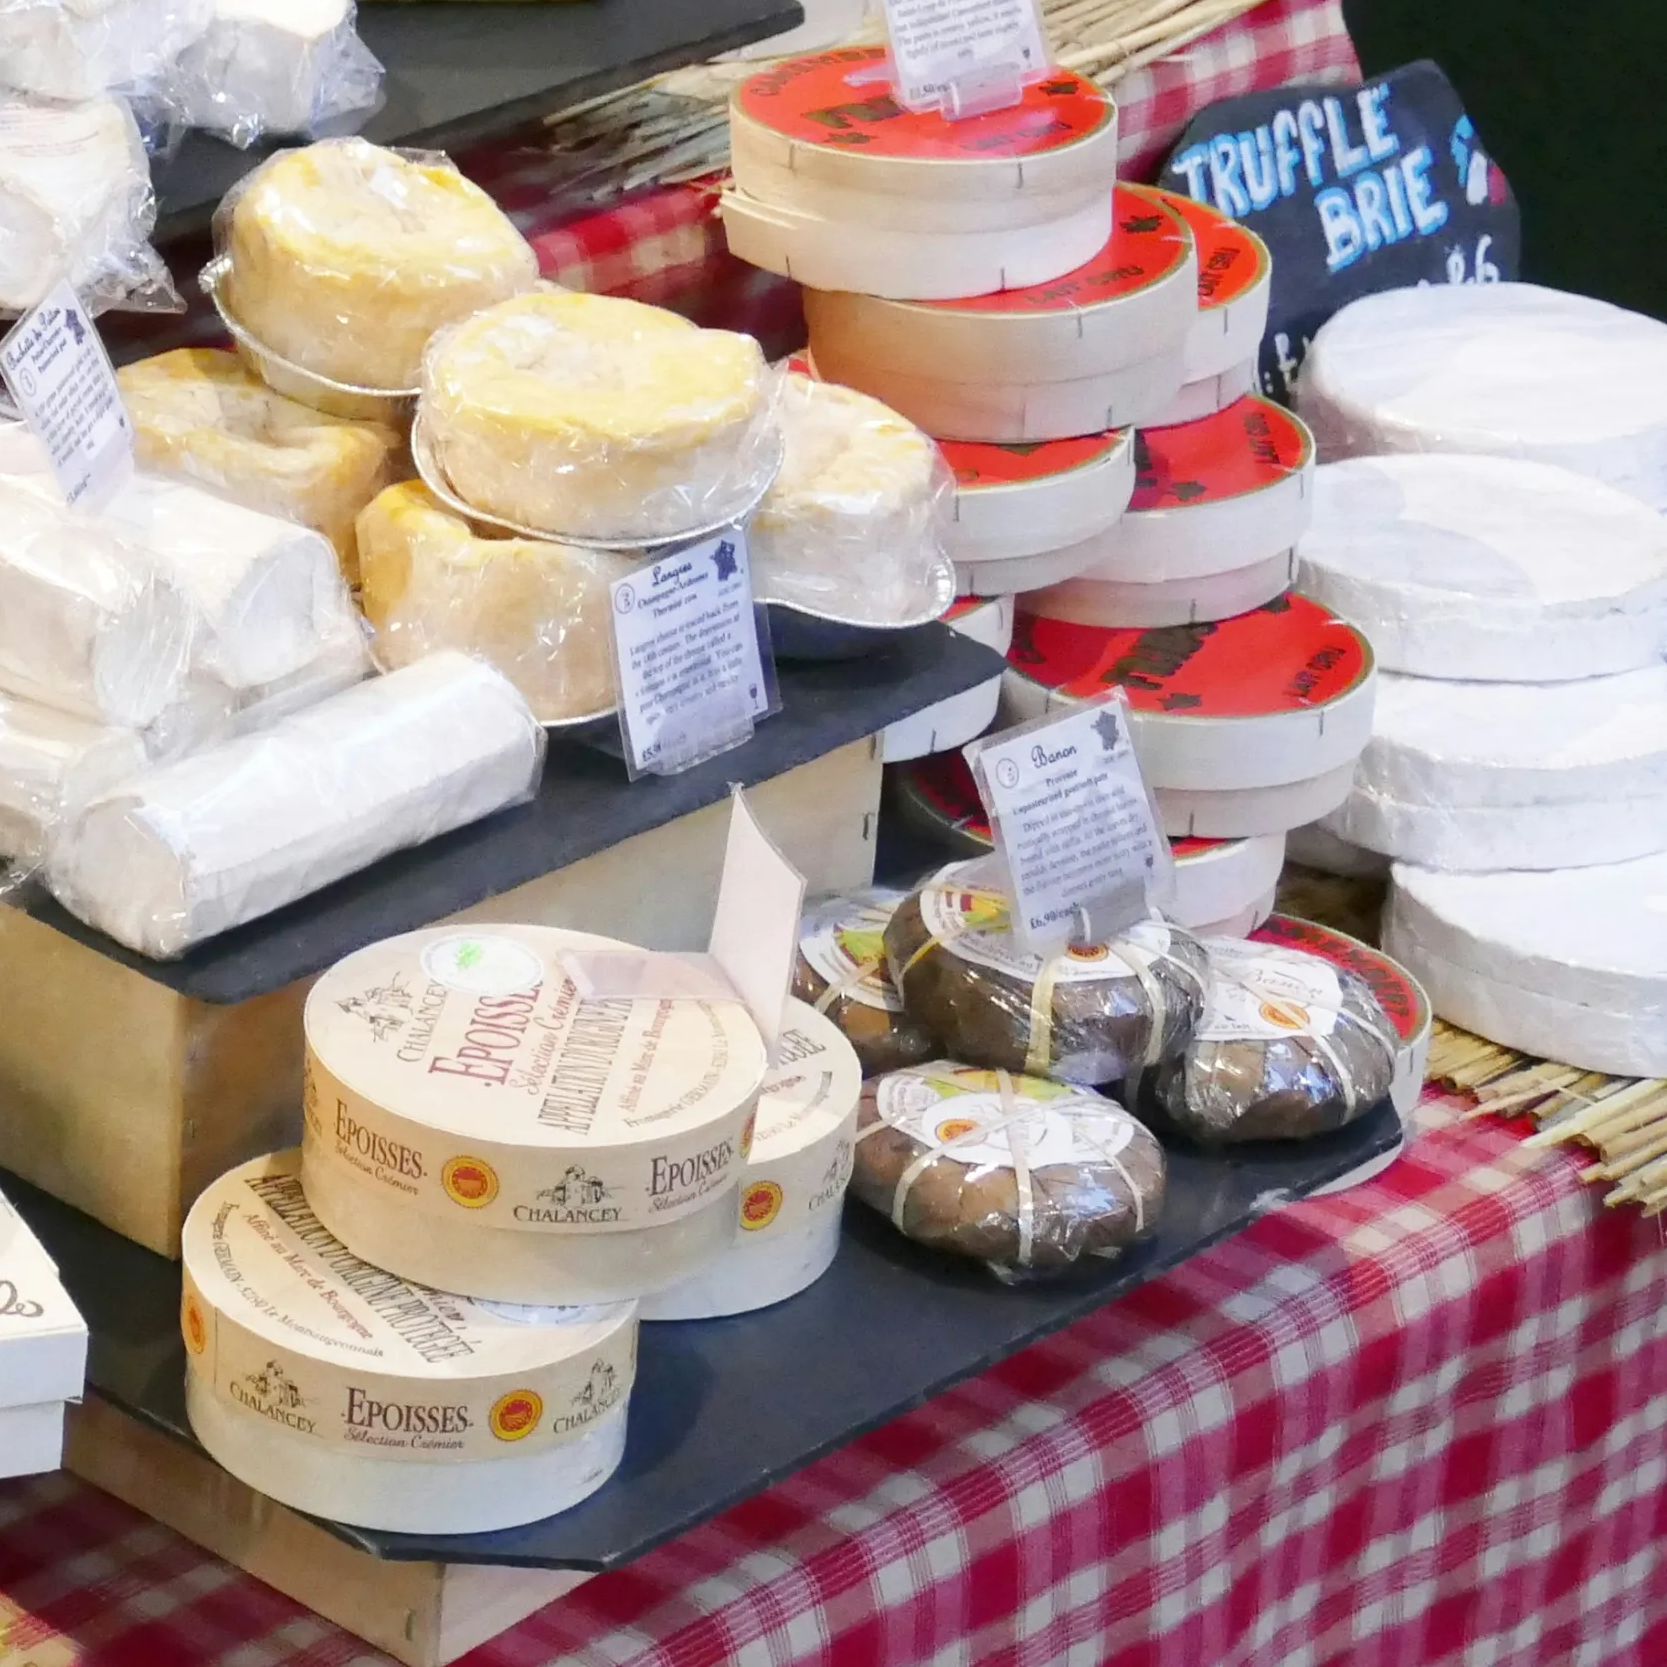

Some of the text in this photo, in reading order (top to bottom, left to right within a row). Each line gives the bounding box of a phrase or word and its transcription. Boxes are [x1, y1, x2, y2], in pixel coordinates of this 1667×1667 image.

[1171, 82, 1399, 218] TRUFFLE
[1315, 145, 1449, 275] BRIE
[1031, 744, 1077, 769] Banon
[334, 1099, 425, 1181] EPOISSES
[513, 1204, 624, 1223] CHALANCEY
[229, 1382, 317, 1435] CHALANCEY
[344, 1386, 469, 1434] EPOISSES
